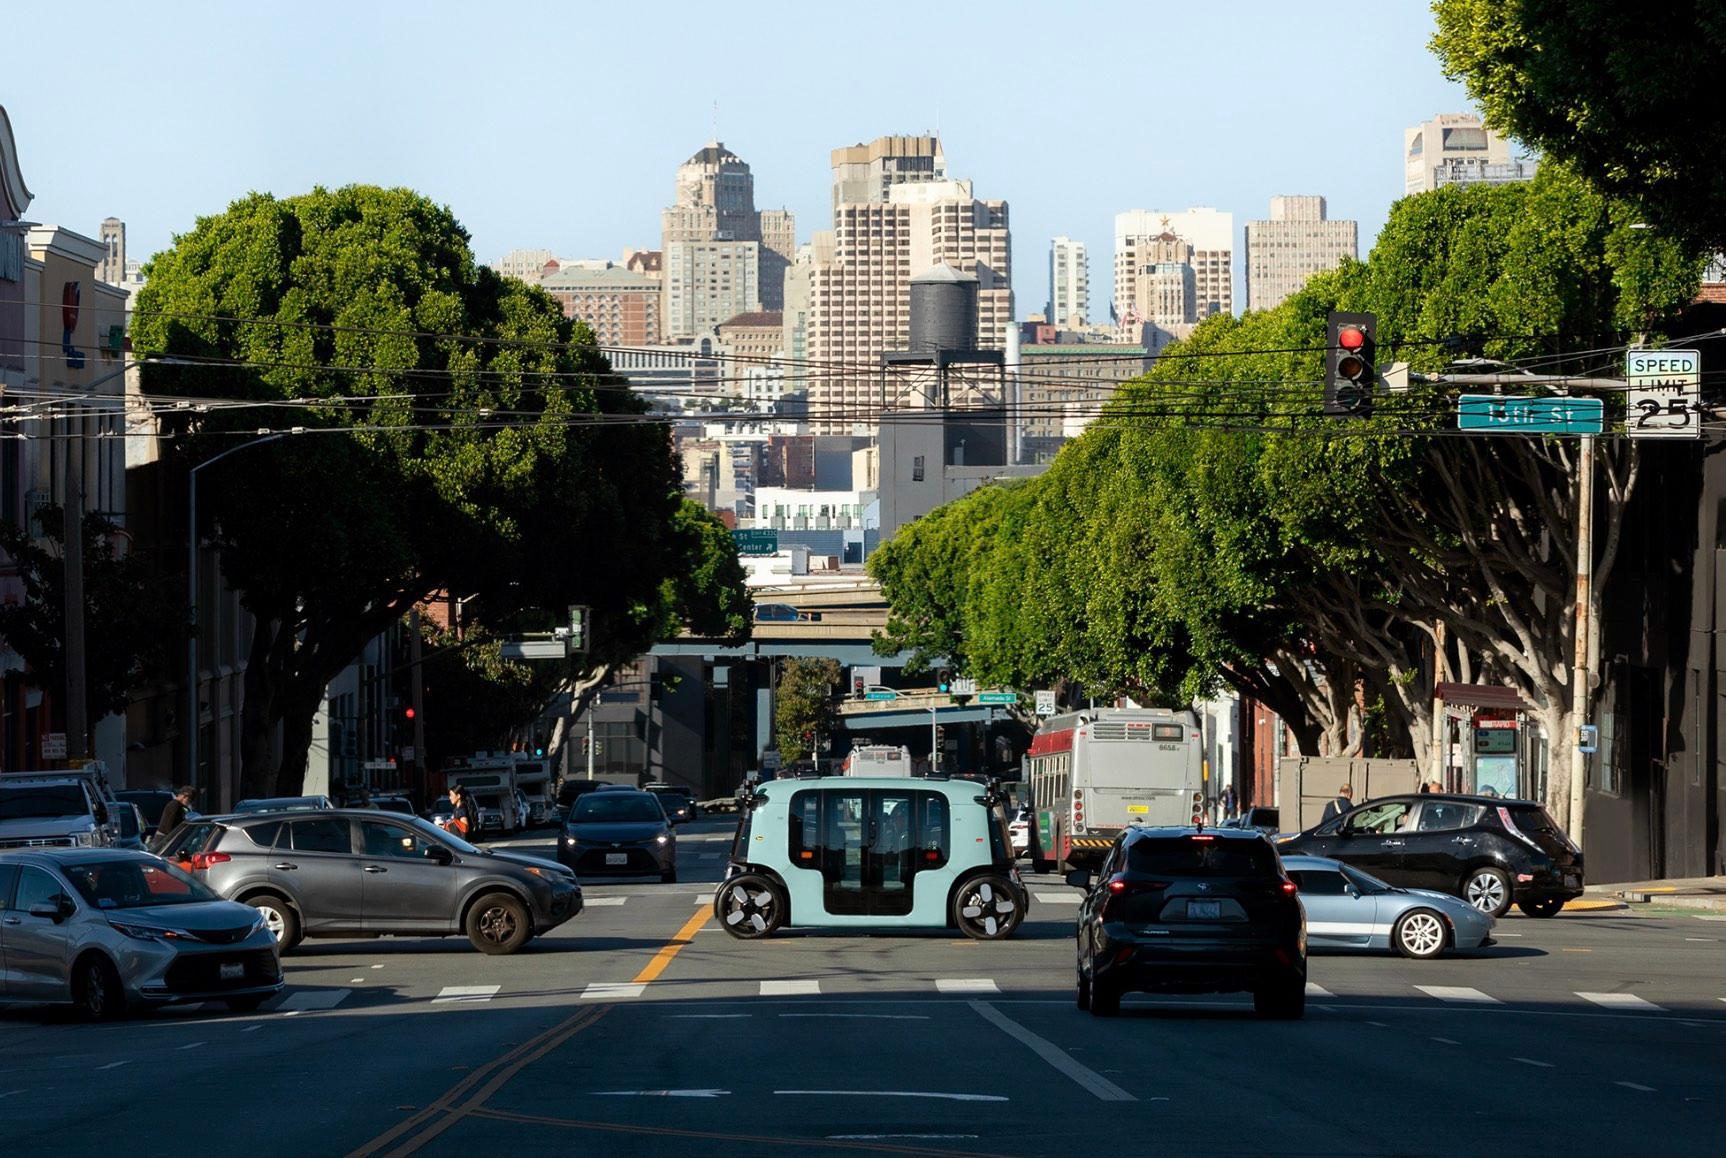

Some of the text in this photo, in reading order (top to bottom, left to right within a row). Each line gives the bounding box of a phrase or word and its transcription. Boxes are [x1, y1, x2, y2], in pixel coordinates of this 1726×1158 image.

[1635, 359, 1692, 372] SPEED
[1639, 379, 1688, 392] LIMIT
[1550, 407, 1573, 424] St
[1636, 399, 1691, 429] 25
[1038, 703, 1053, 712] 25
